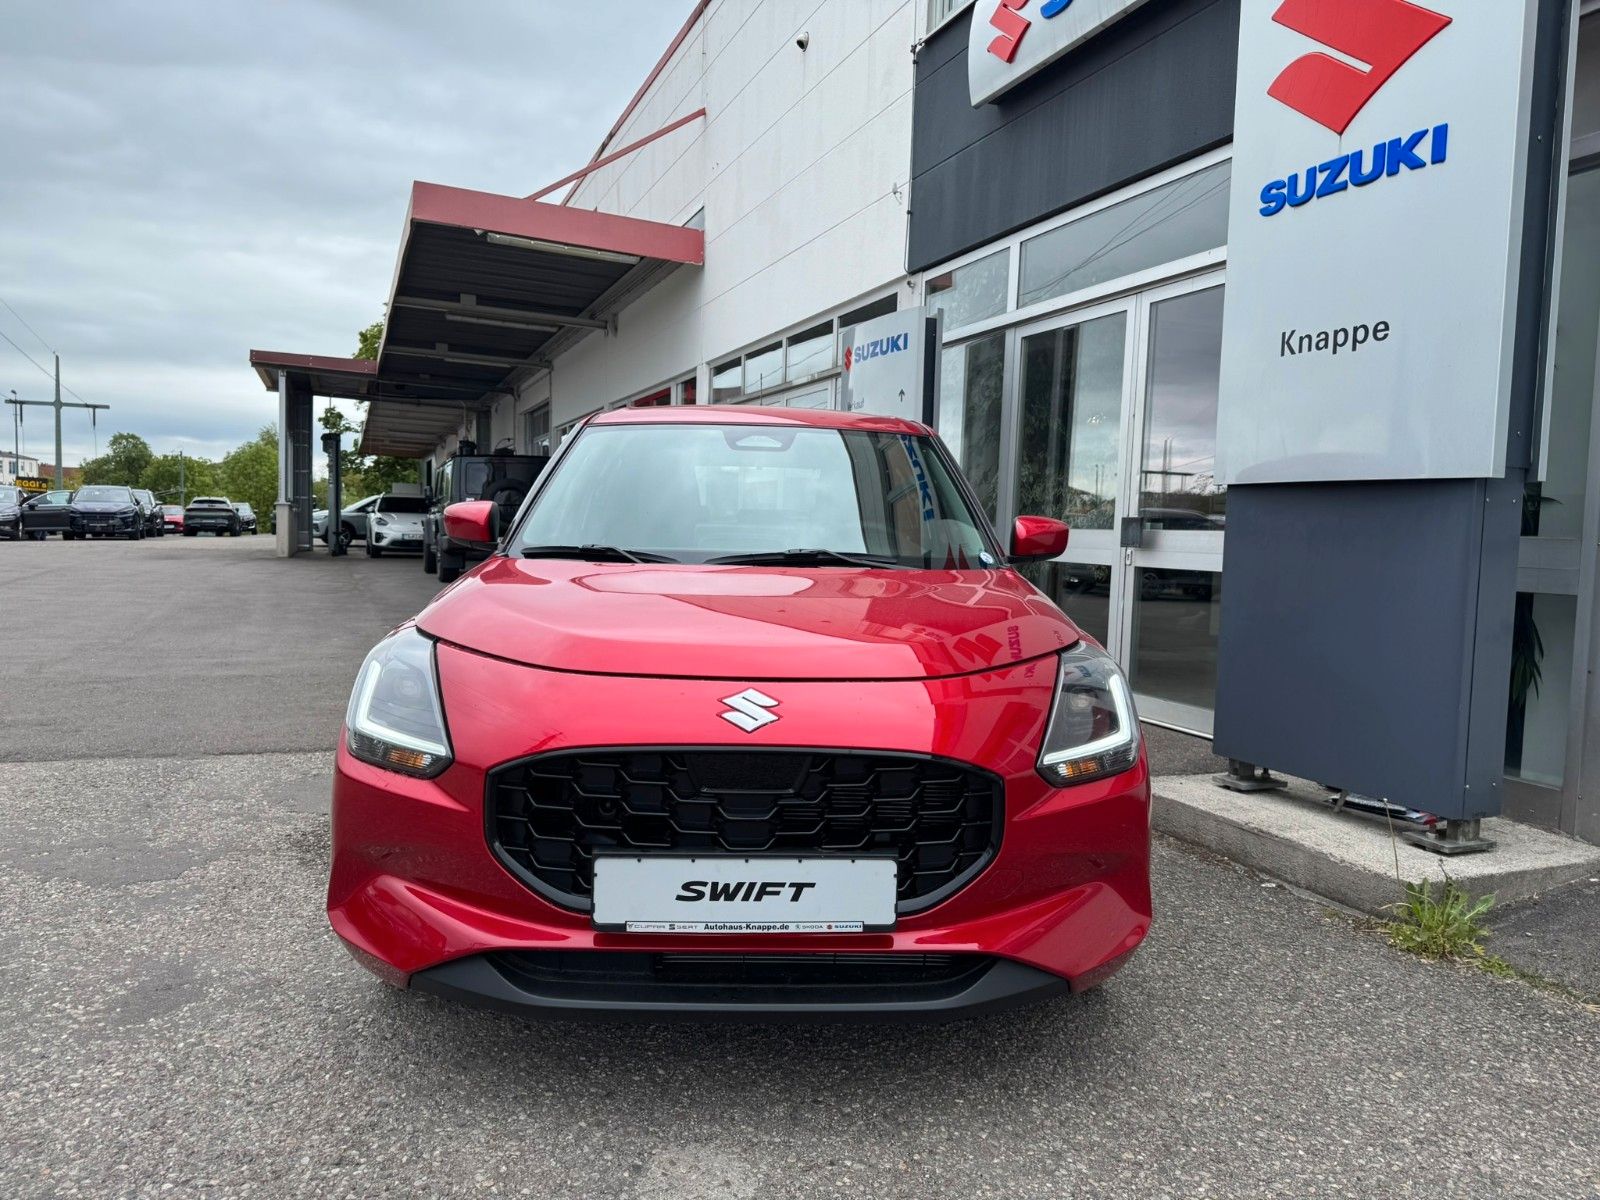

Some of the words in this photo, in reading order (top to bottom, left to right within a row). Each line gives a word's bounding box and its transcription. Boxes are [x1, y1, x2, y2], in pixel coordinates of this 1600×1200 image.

[1259, 123, 1448, 217] SUZUKI
[854, 332, 908, 363] SUZUKI
[1280, 319, 1390, 357] Knappe
[675, 880, 816, 902] SWIFT
[704, 923, 790, 931] Autohaus-Knappe.de
